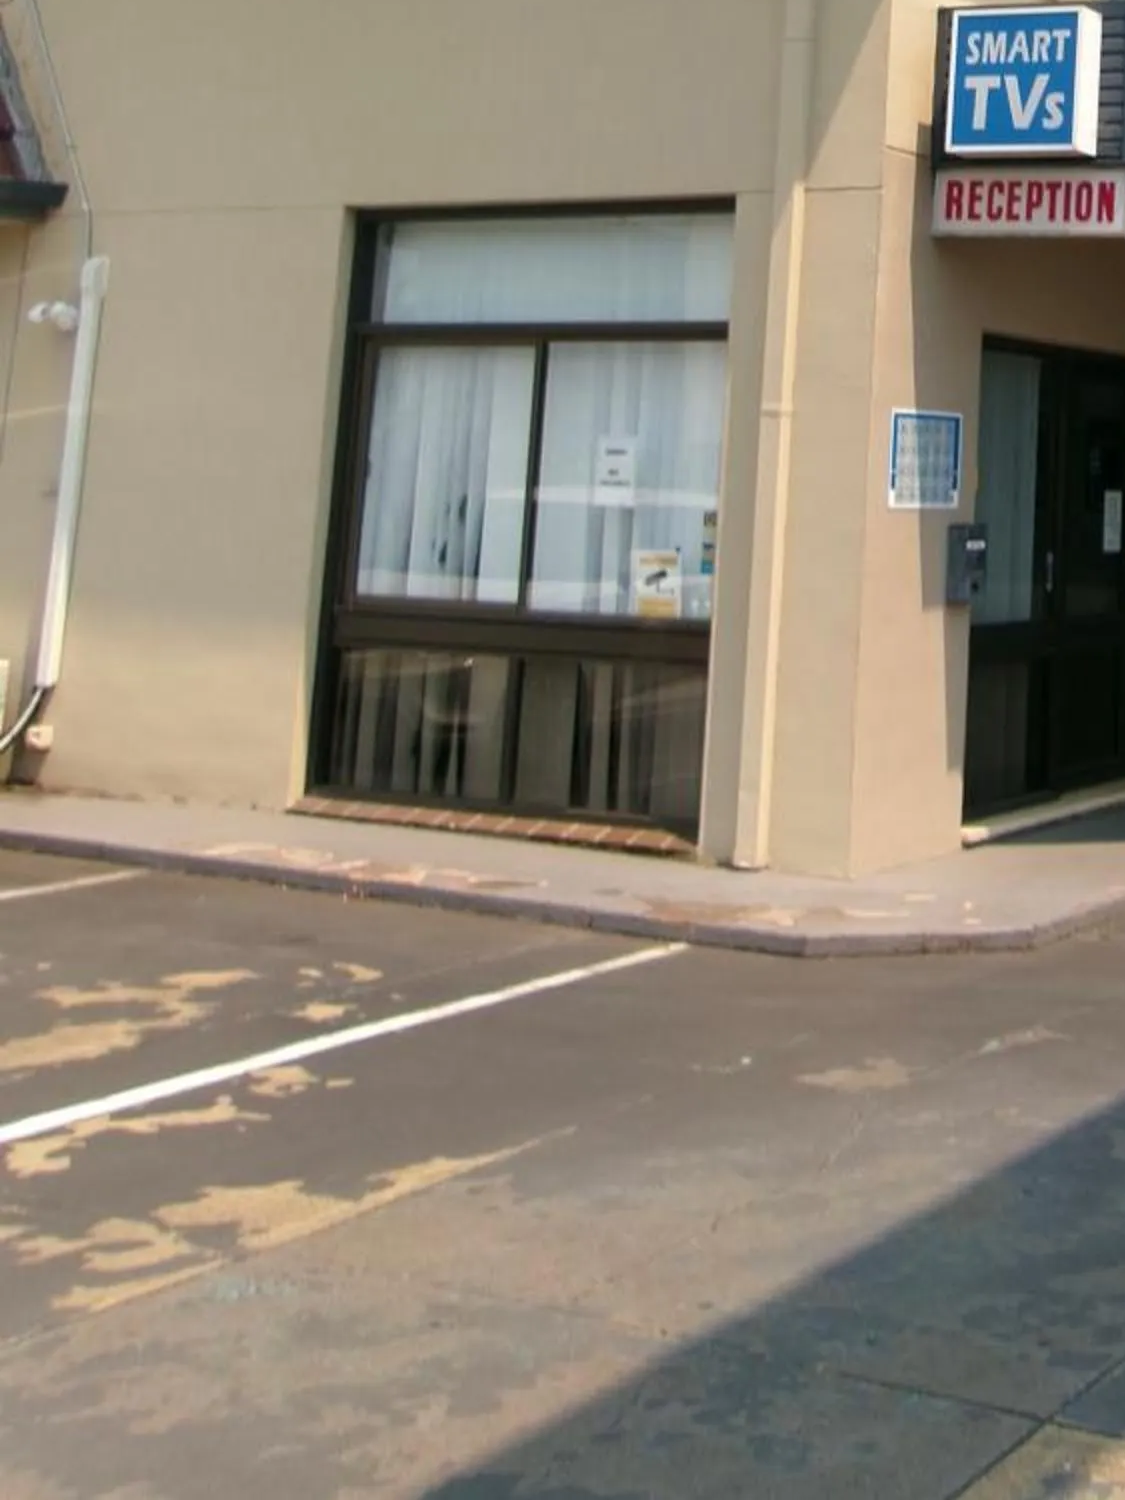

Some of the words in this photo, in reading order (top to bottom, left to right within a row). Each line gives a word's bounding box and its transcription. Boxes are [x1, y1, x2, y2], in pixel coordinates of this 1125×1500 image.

[965, 30, 1071, 65] SMART
[964, 73, 1065, 131] TVs
[945, 179, 1117, 224] RECEPTION
